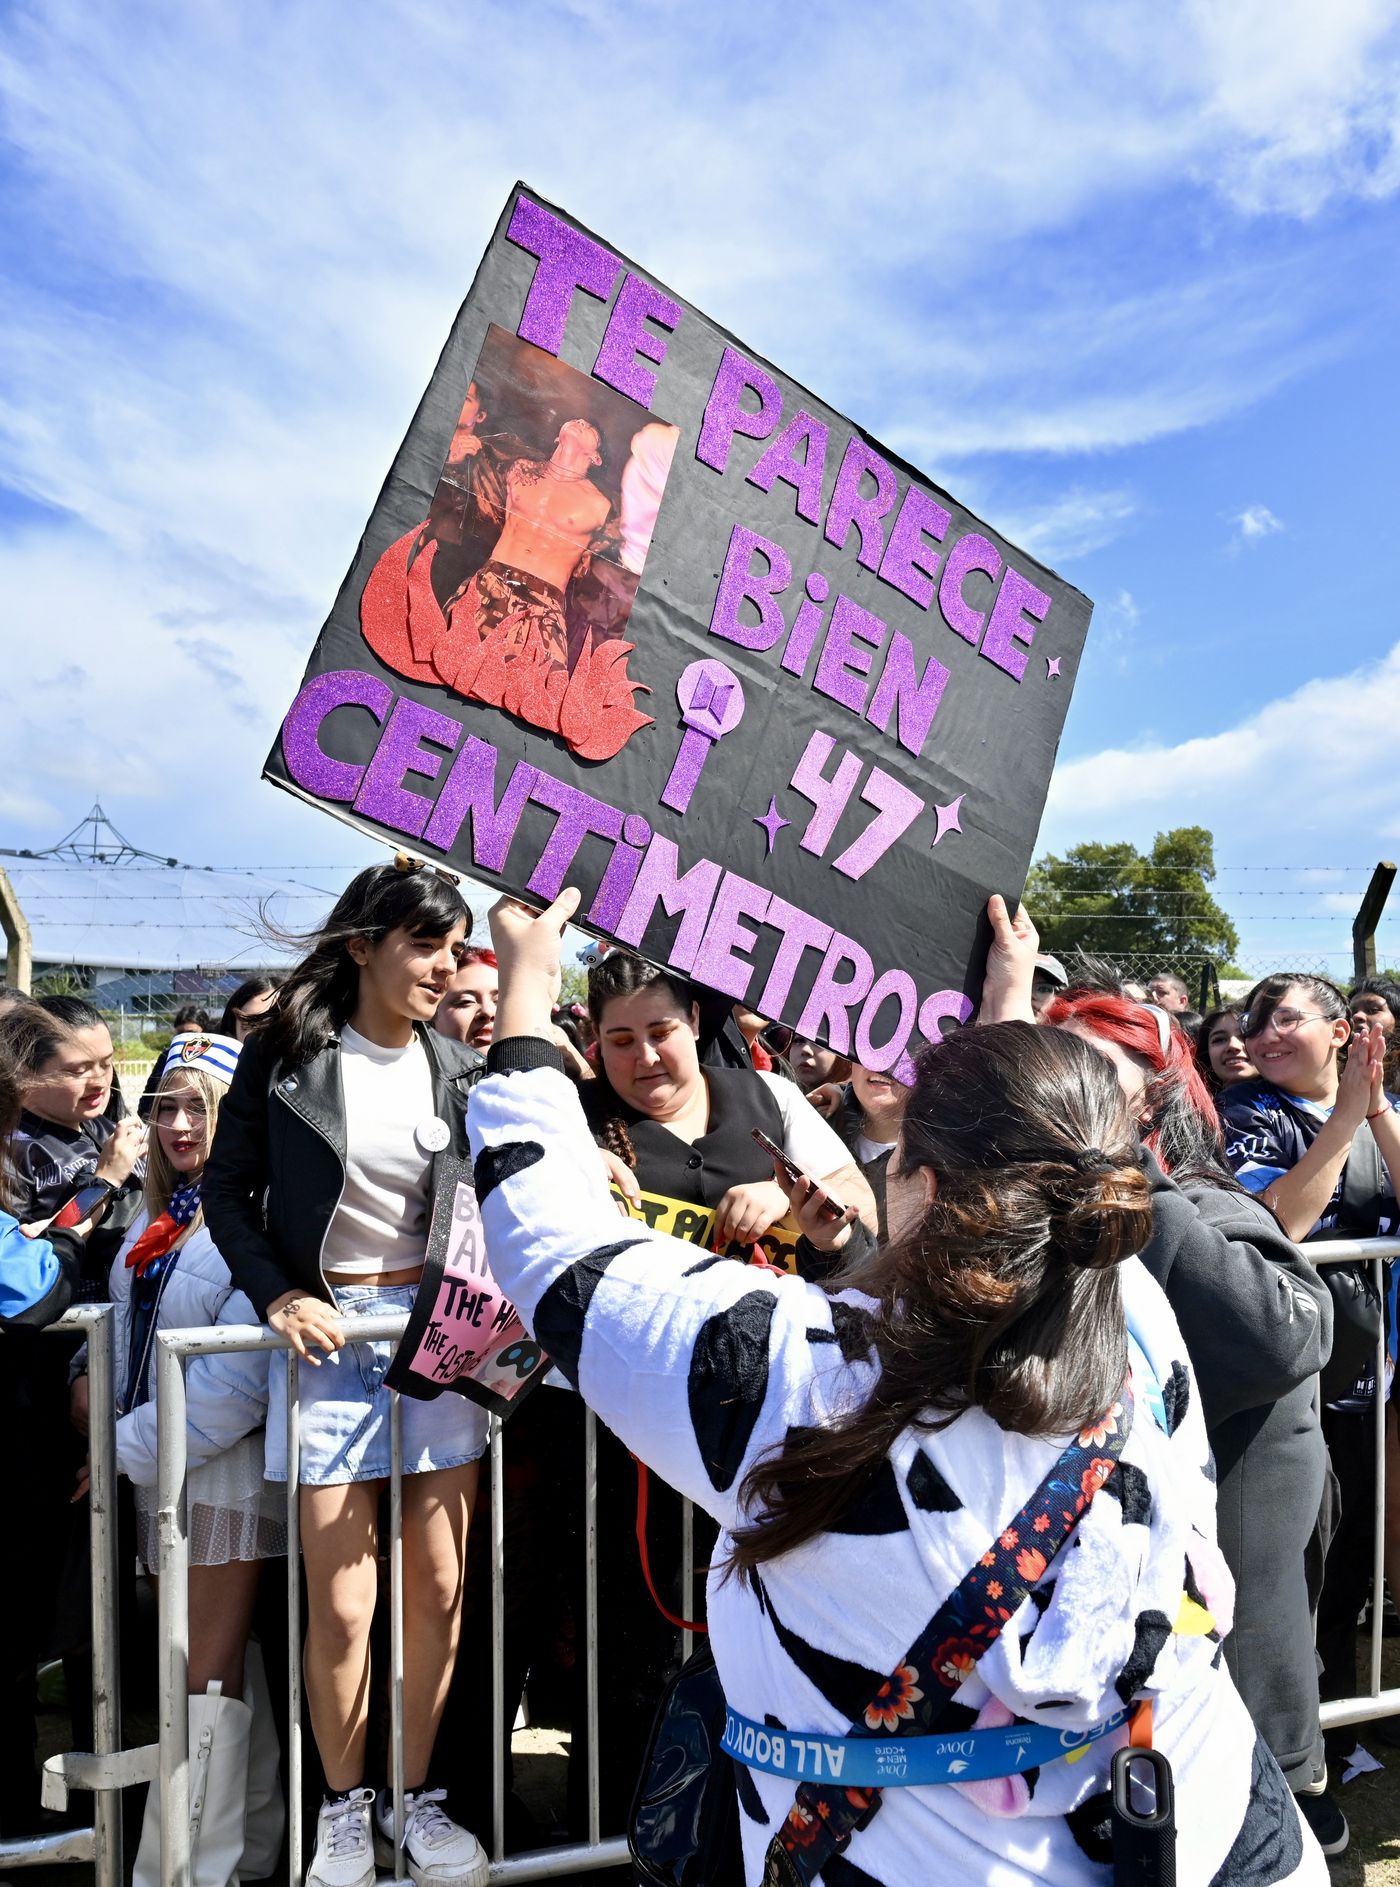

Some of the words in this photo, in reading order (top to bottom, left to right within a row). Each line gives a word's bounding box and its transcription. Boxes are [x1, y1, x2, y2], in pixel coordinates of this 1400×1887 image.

[506, 196, 682, 410] TE
[695, 346, 1053, 683] PARECE
[788, 729, 926, 882] 47
[443, 1275, 493, 1328] THE
[424, 1321, 449, 1355] THE
[733, 1722, 786, 1769] BODY
[790, 1739, 846, 1777] ALL
[887, 1755, 907, 1763] MEN
[936, 1740, 975, 1757] Dove
[876, 1764, 908, 1778] Dove
